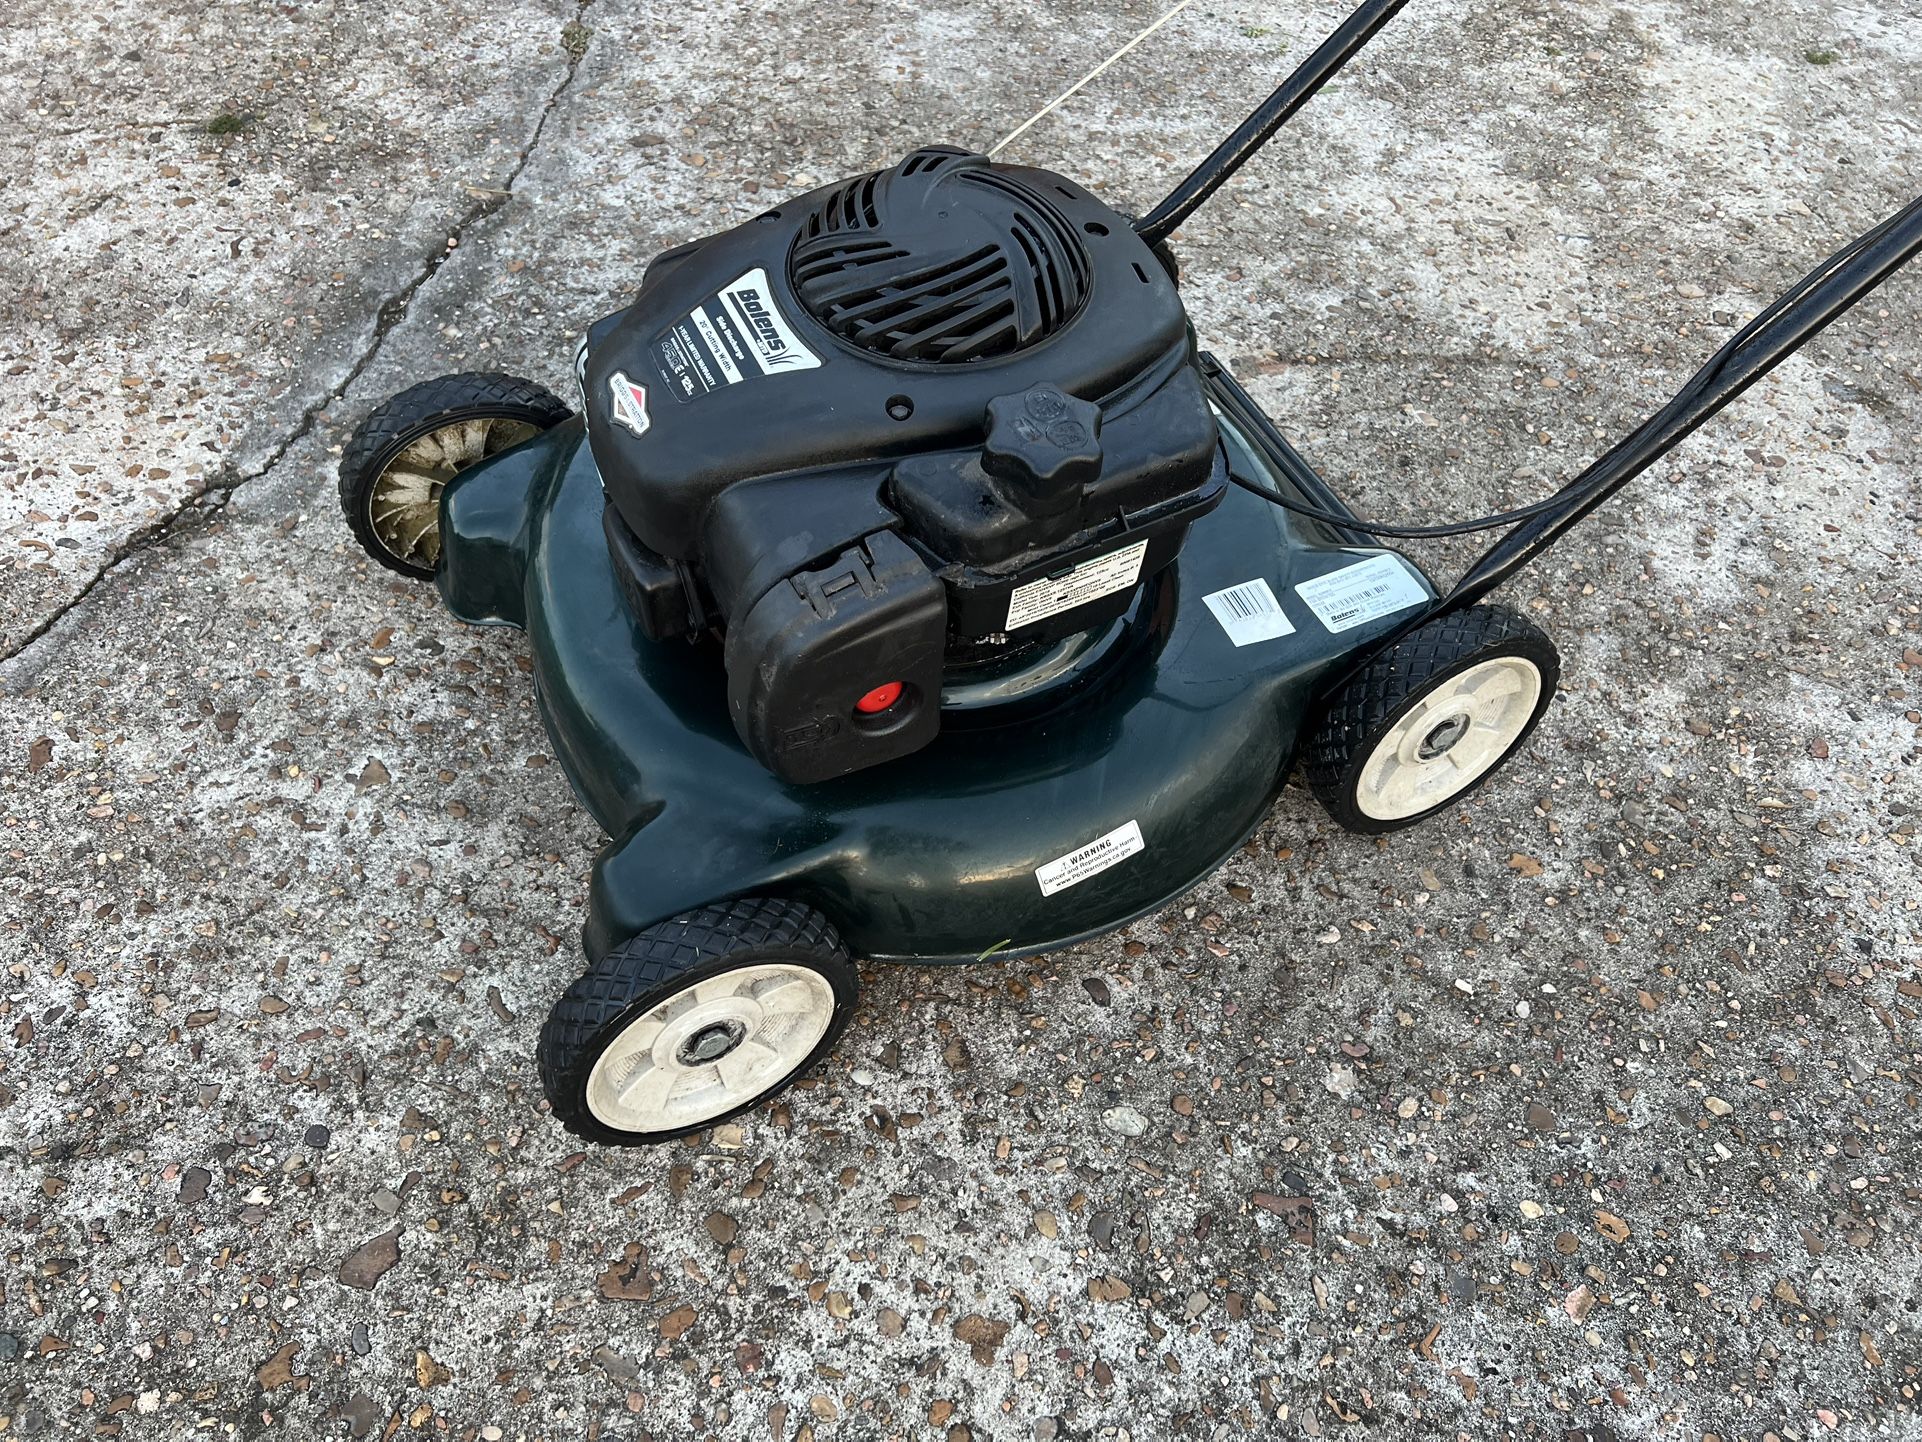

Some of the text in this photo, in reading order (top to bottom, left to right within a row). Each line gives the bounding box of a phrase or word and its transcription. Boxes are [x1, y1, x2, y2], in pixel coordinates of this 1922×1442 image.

[716, 315, 744, 360] Side Discharge
[737, 289, 786, 350] Bolens
[686, 340, 701, 360] LIMITED
[696, 358, 716, 386] WARRANTY
[706, 330, 721, 353] Cutting
[719, 352, 732, 371] Width
[1043, 836, 1136, 885] Cancer and Reproductive Harm
[1070, 839, 1112, 865] WARNING
